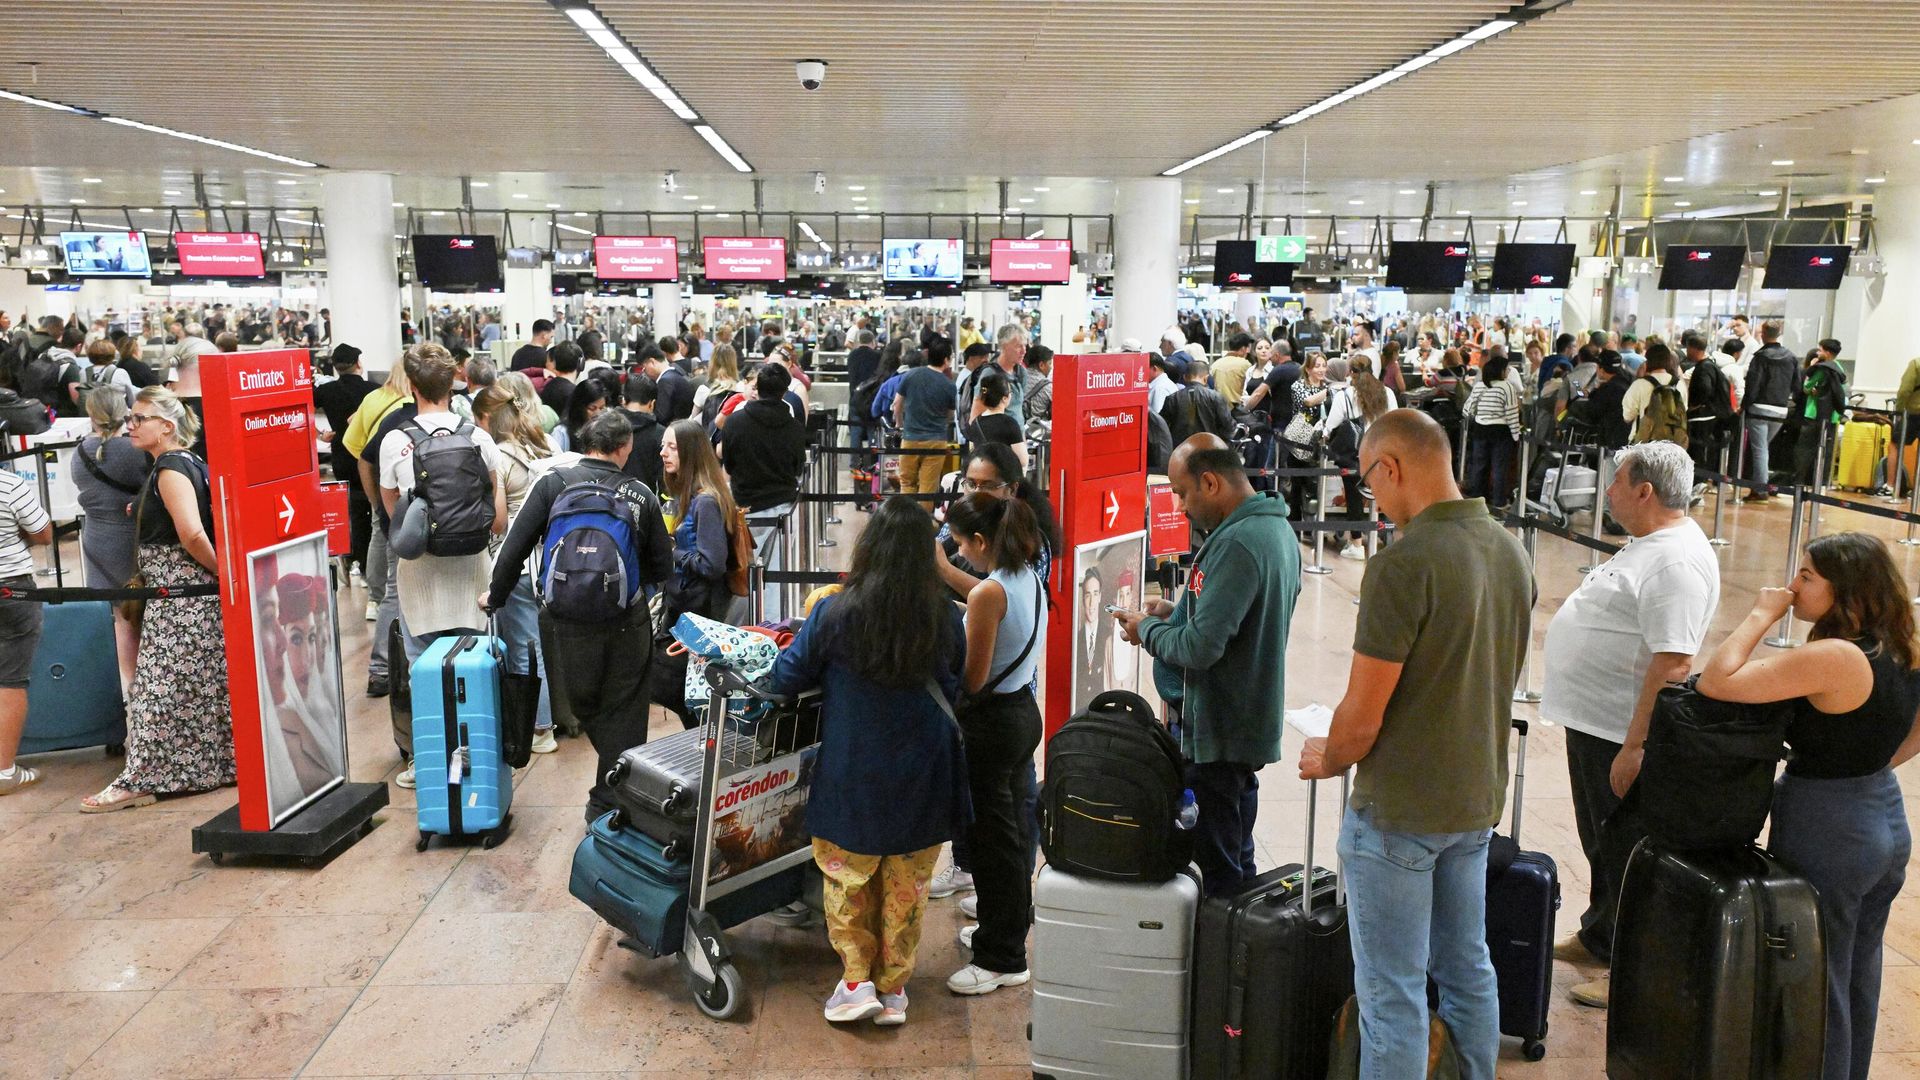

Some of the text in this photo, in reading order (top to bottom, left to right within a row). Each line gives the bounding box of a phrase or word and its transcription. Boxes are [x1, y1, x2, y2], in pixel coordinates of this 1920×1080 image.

[1010, 241, 1039, 249] Emirates
[1008, 262, 1036, 270] Economy
[1351, 258, 1373, 269] 1.4
[239, 369, 285, 391] Emirates
[1086, 369, 1125, 389] Emirates
[245, 410, 304, 431] Online Checked-in
[1090, 412, 1134, 428] Economy Class
[715, 768, 789, 812] corendon
